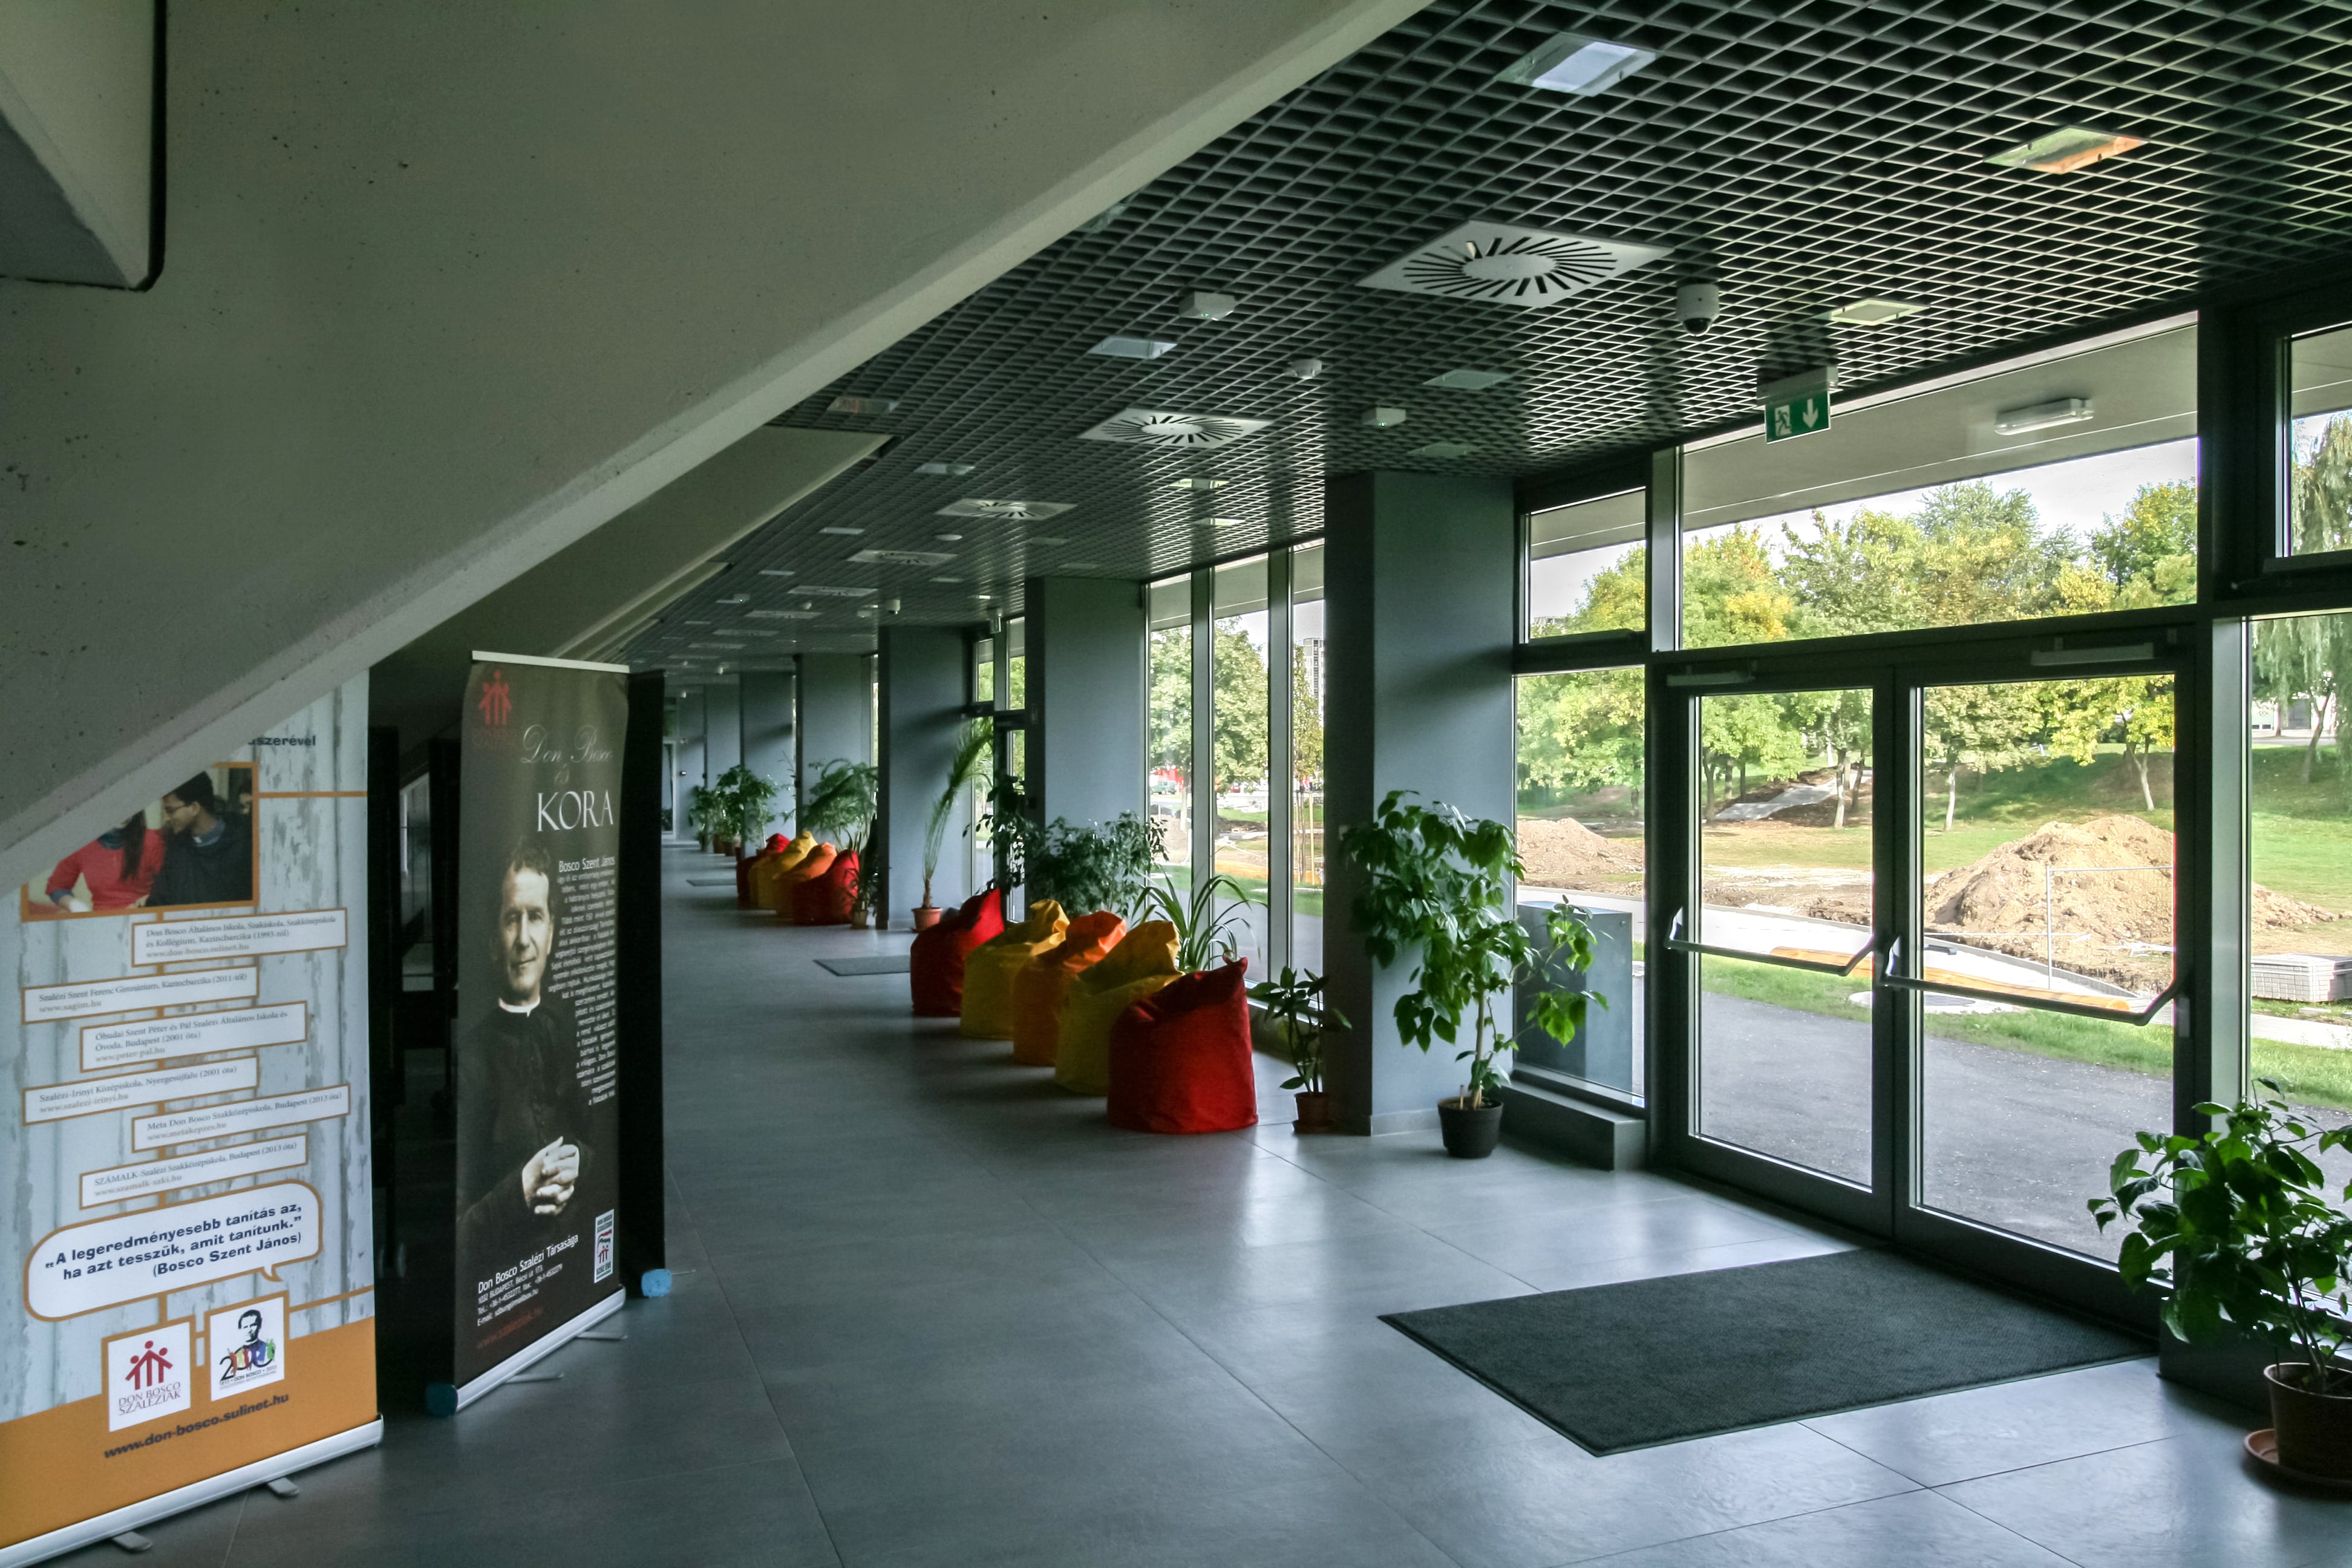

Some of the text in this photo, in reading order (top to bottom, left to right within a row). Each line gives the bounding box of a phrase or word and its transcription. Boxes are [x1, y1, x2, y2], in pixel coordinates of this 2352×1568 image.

[520, 724, 563, 764] Don
[537, 789, 614, 832] KORA
[558, 860, 580, 872] Bosco
[582, 857, 600, 870] Szent
[71, 1219, 221, 1261] legeredményesebb
[226, 1207, 276, 1227] tanítás
[280, 1203, 302, 1215] az,
[153, 1231, 302, 1278] (Bosco Szent János)
[64, 1267, 82, 1280] ha
[87, 1259, 113, 1275] azt
[117, 1244, 185, 1267] tesszük,
[190, 1234, 225, 1251] amit
[478, 1234, 579, 1294] Don Bosco Szalézi Társasága
[119, 1382, 181, 1406] DON BOSCO
[103, 1393, 290, 1459] www.don-bosco.sulinet.hu
